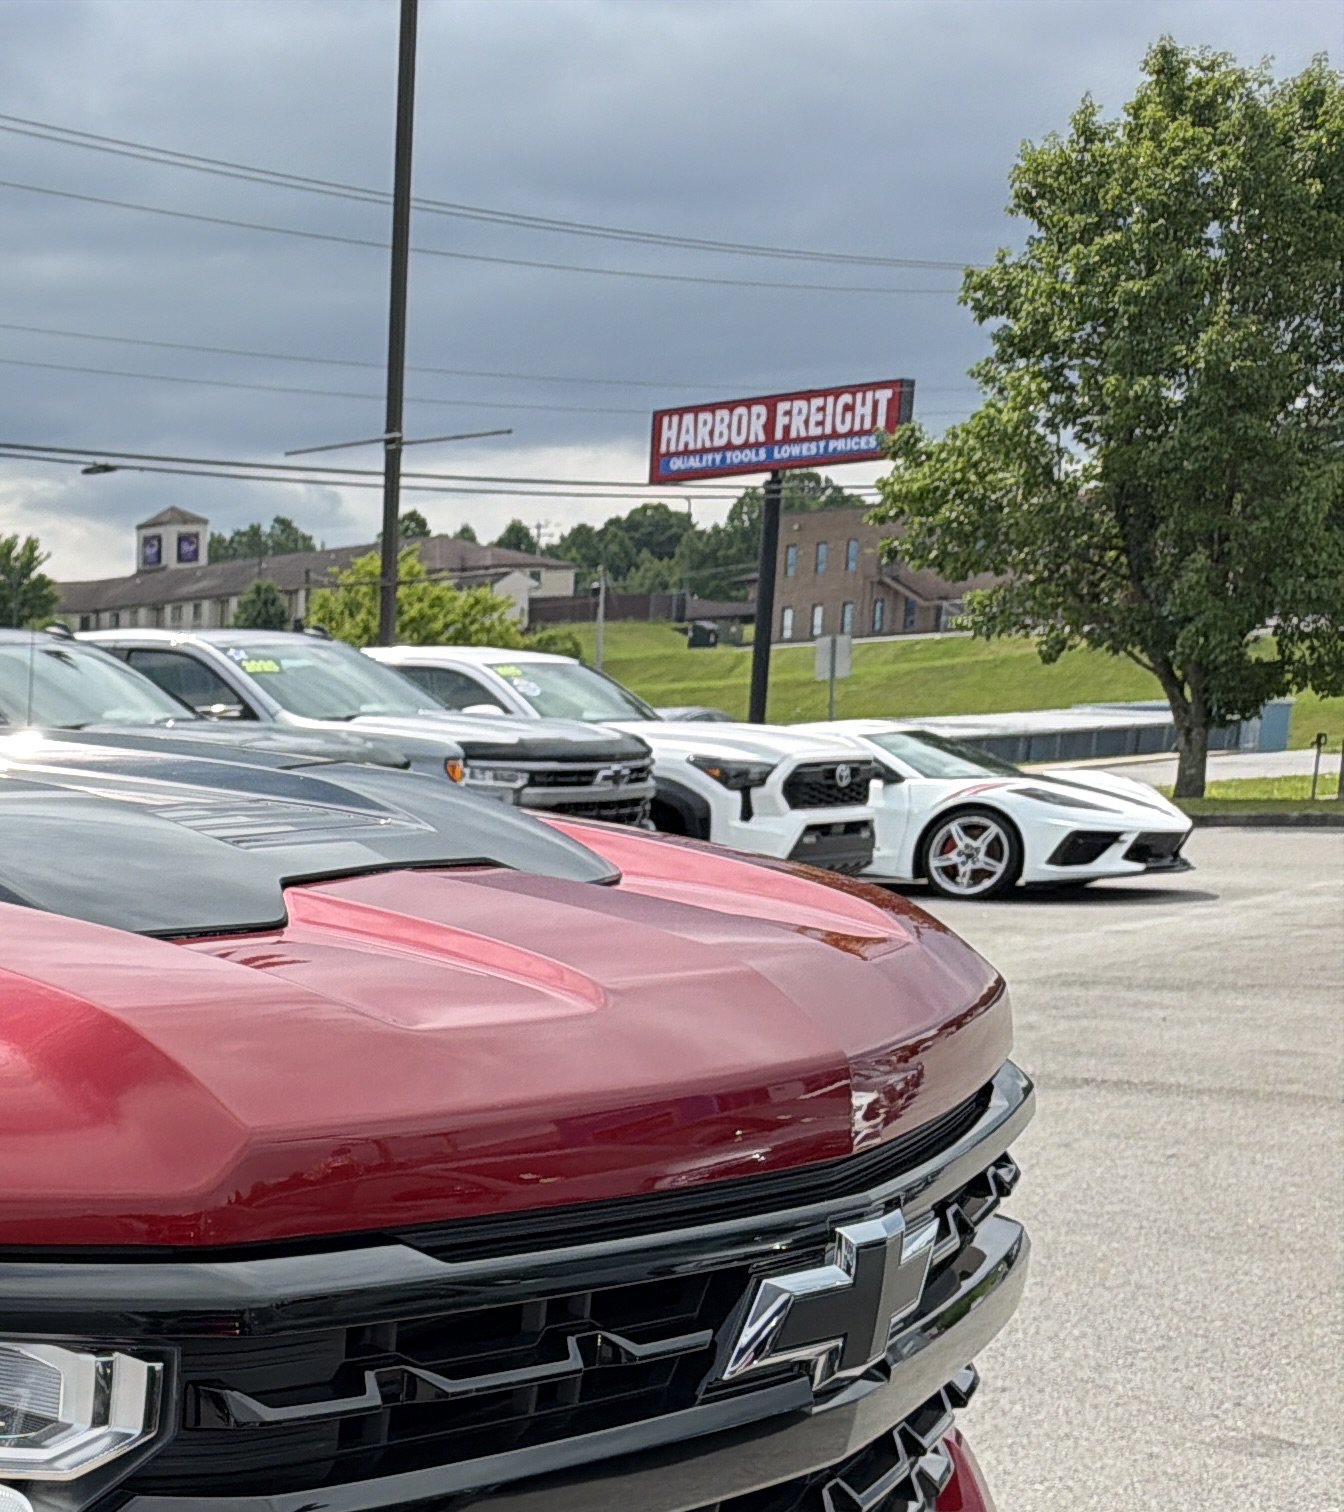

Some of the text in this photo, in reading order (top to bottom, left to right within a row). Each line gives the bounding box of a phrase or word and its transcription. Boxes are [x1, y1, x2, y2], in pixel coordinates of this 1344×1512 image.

[659, 388, 894, 454] HARBOR FREIGHT
[669, 434, 878, 471] QUALITY TOOLS LOWEST PRICES
